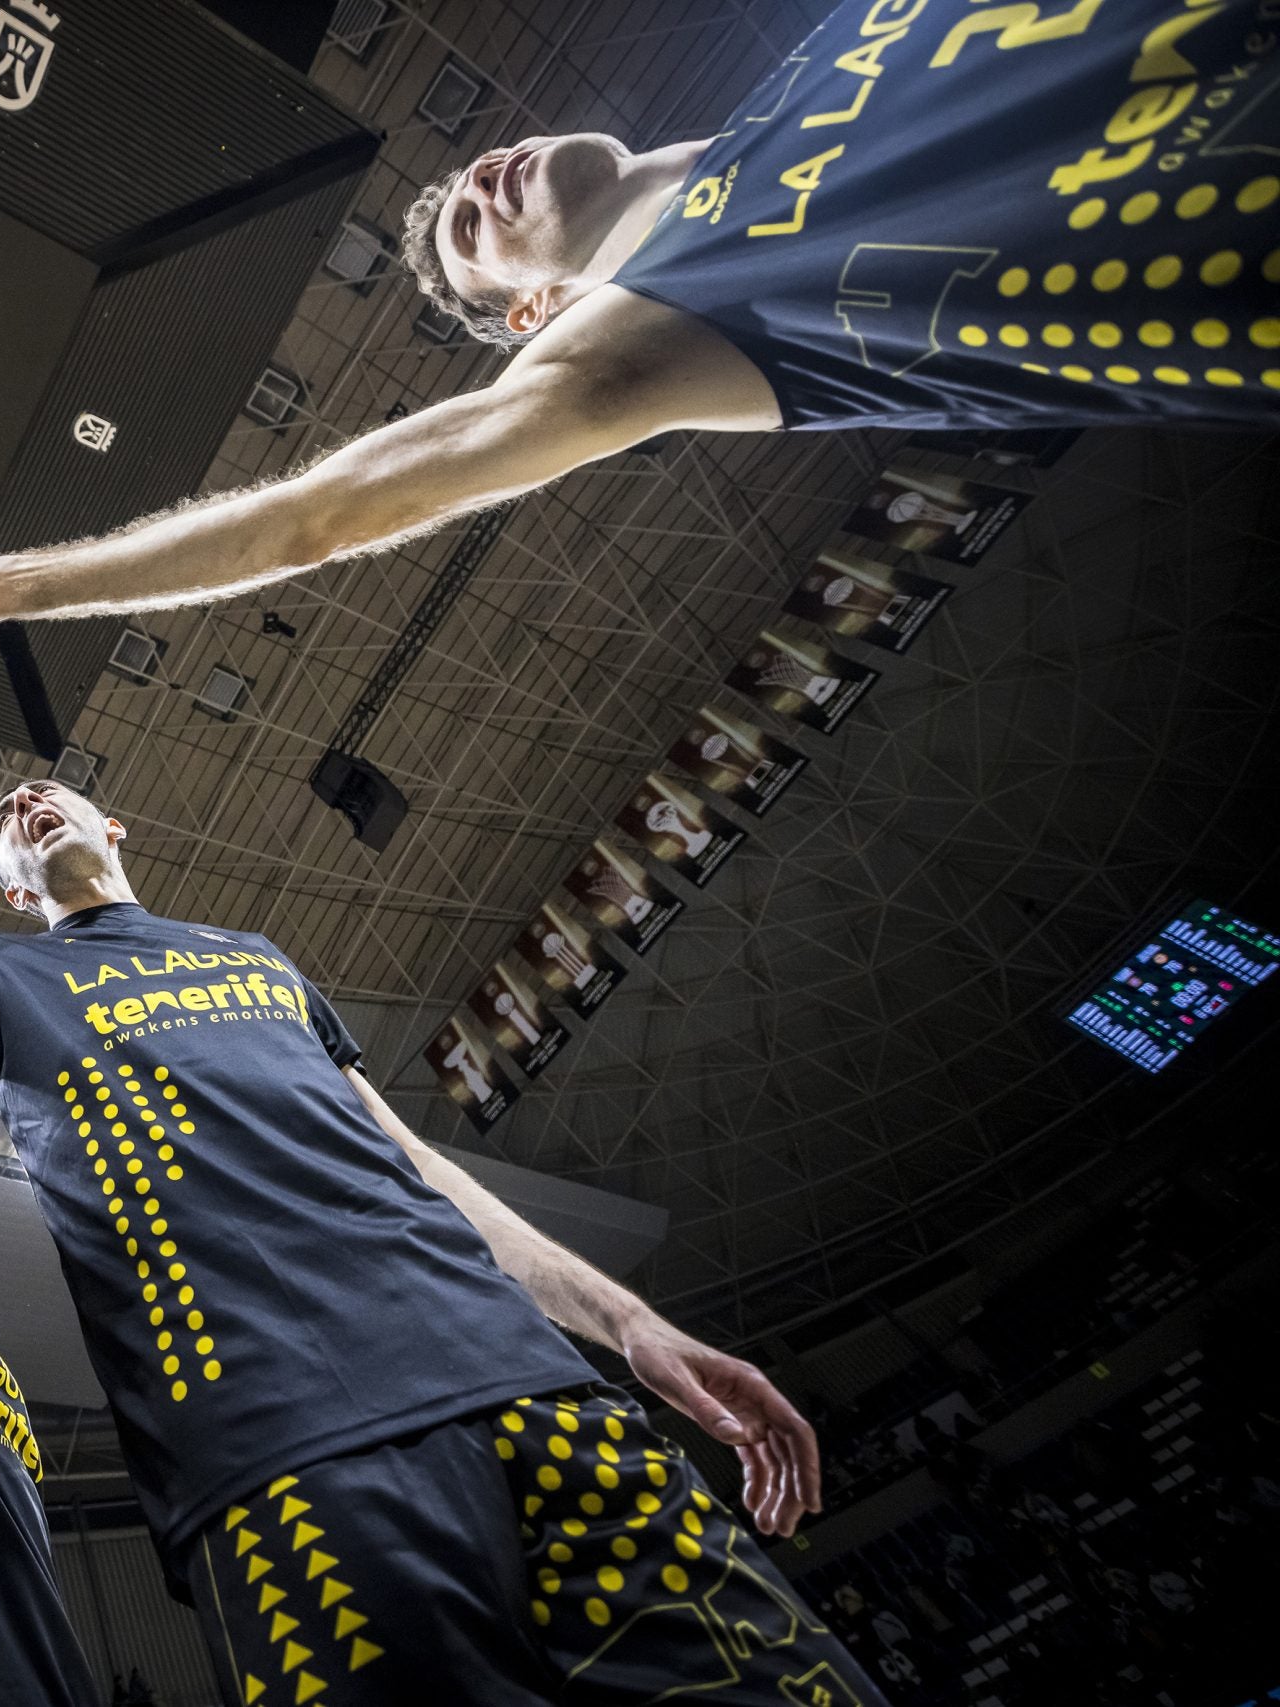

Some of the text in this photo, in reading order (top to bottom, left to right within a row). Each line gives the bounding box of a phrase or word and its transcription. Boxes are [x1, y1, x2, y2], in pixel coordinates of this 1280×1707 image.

[1047, 0, 1228, 195] ten
[748, 145, 844, 238] LA
[63, 949, 299, 994] LA LAGUNA
[103, 1014, 199, 1051] awakens
